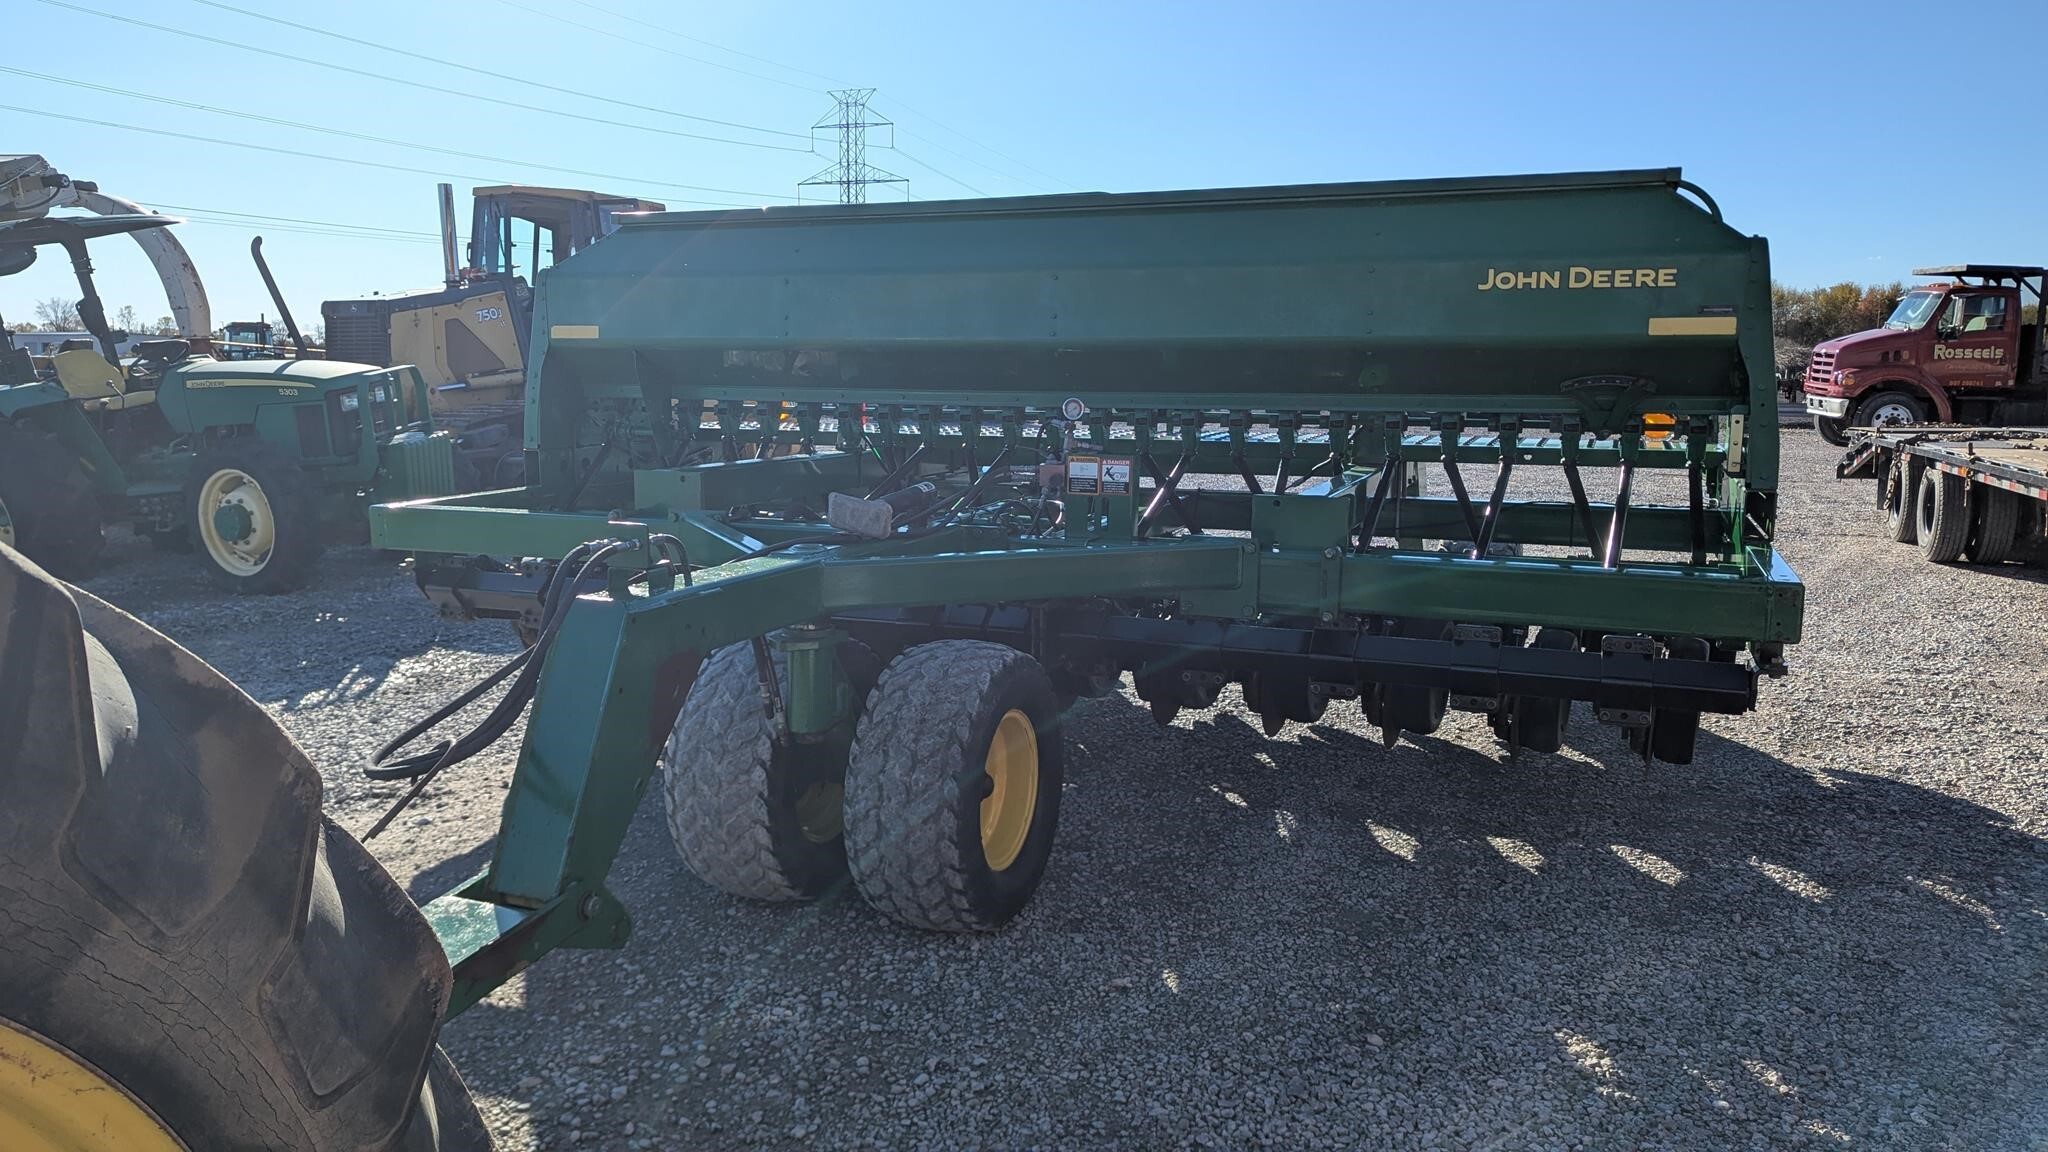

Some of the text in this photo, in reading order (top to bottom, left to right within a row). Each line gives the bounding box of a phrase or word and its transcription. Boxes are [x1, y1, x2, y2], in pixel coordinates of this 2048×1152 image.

[1477, 266, 1678, 290] JOHN DEERE
[278, 388, 298, 396] 5303
